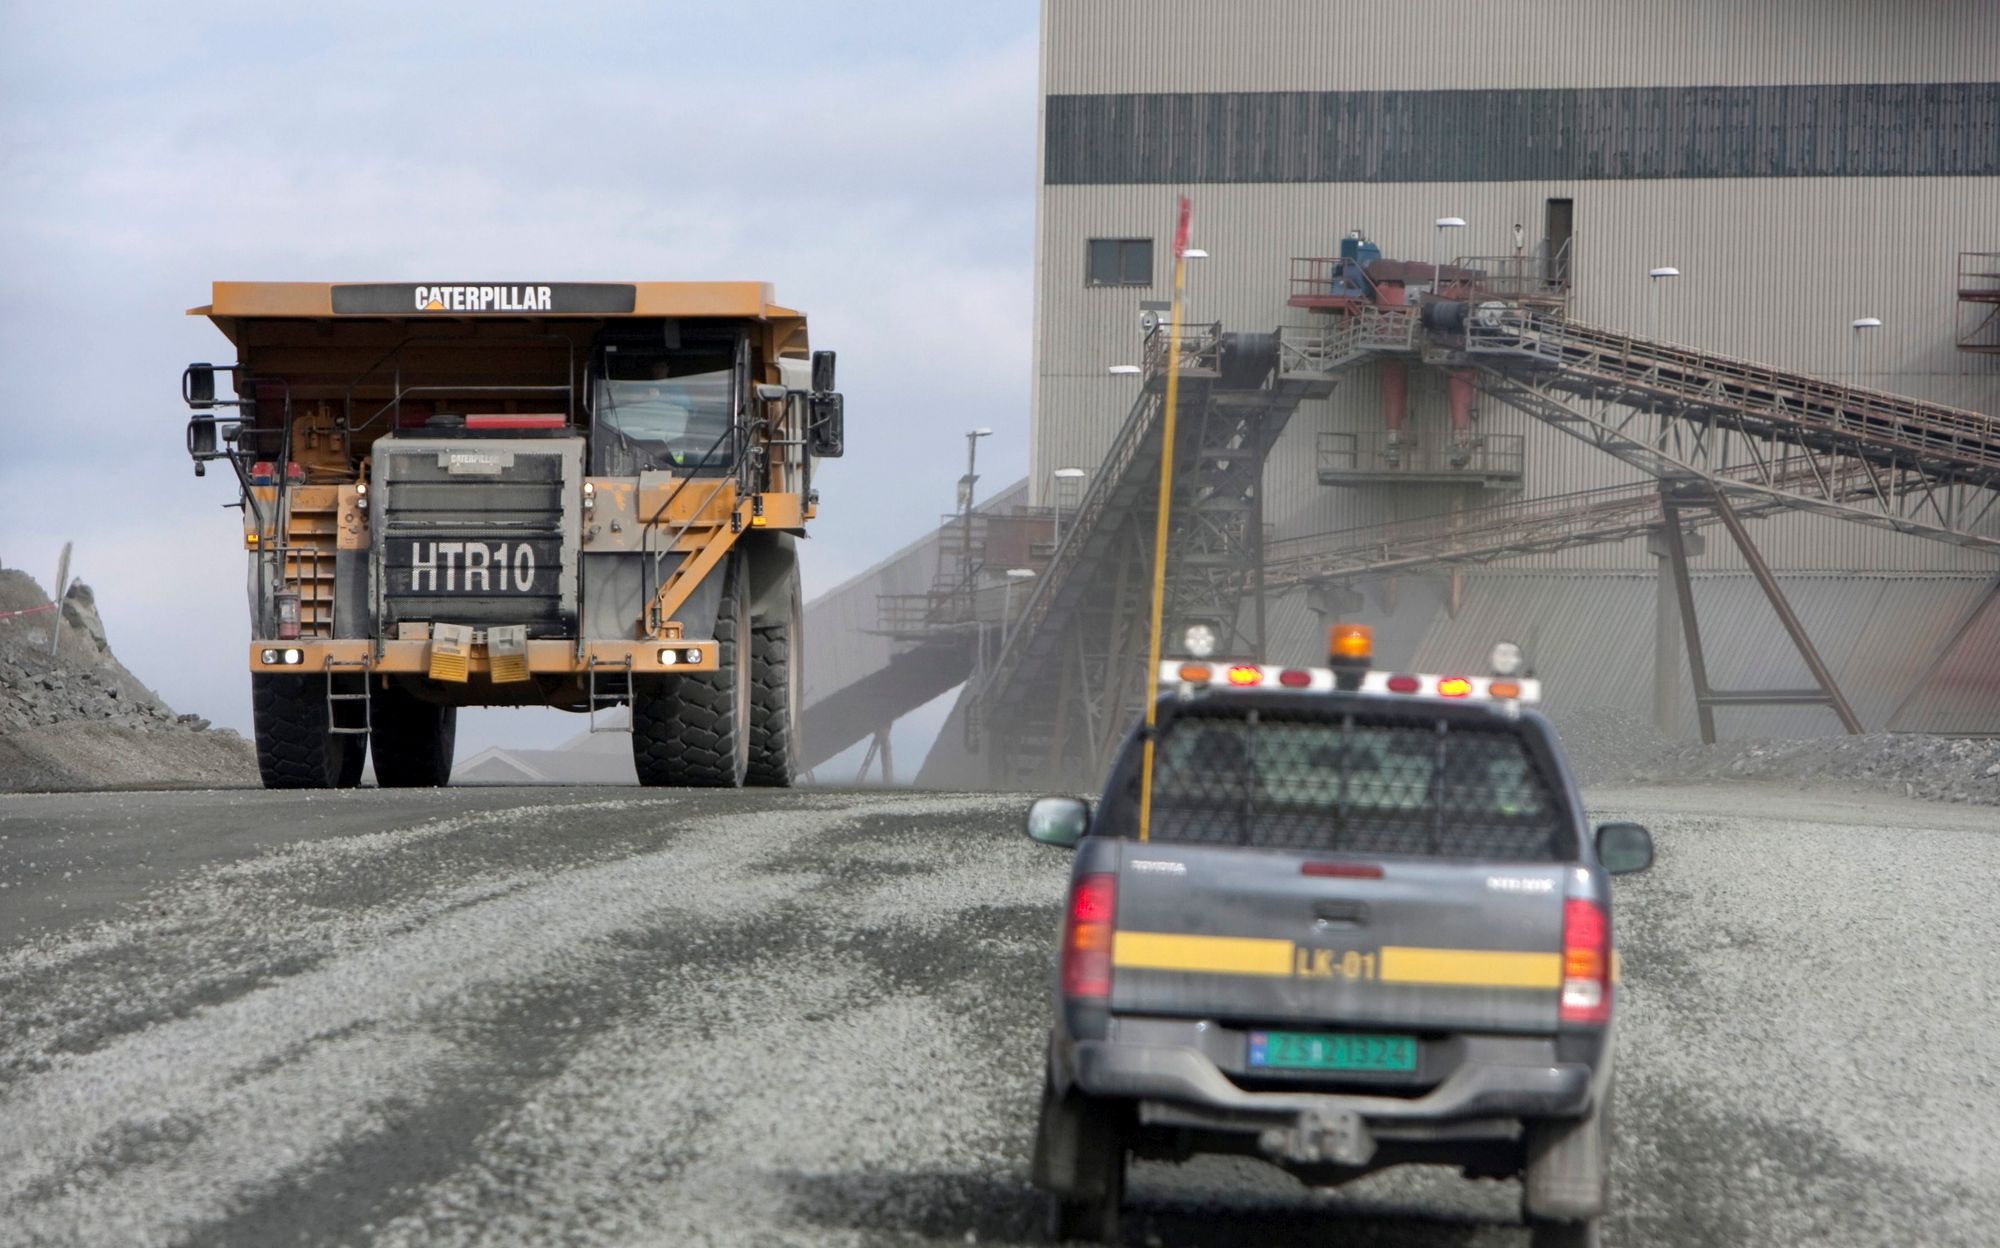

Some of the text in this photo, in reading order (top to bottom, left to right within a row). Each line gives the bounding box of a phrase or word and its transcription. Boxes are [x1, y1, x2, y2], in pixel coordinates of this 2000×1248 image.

[414, 286, 552, 310] CATERPILLAR
[412, 542, 535, 592] HTR10
[1296, 947, 1375, 979] LK-01
